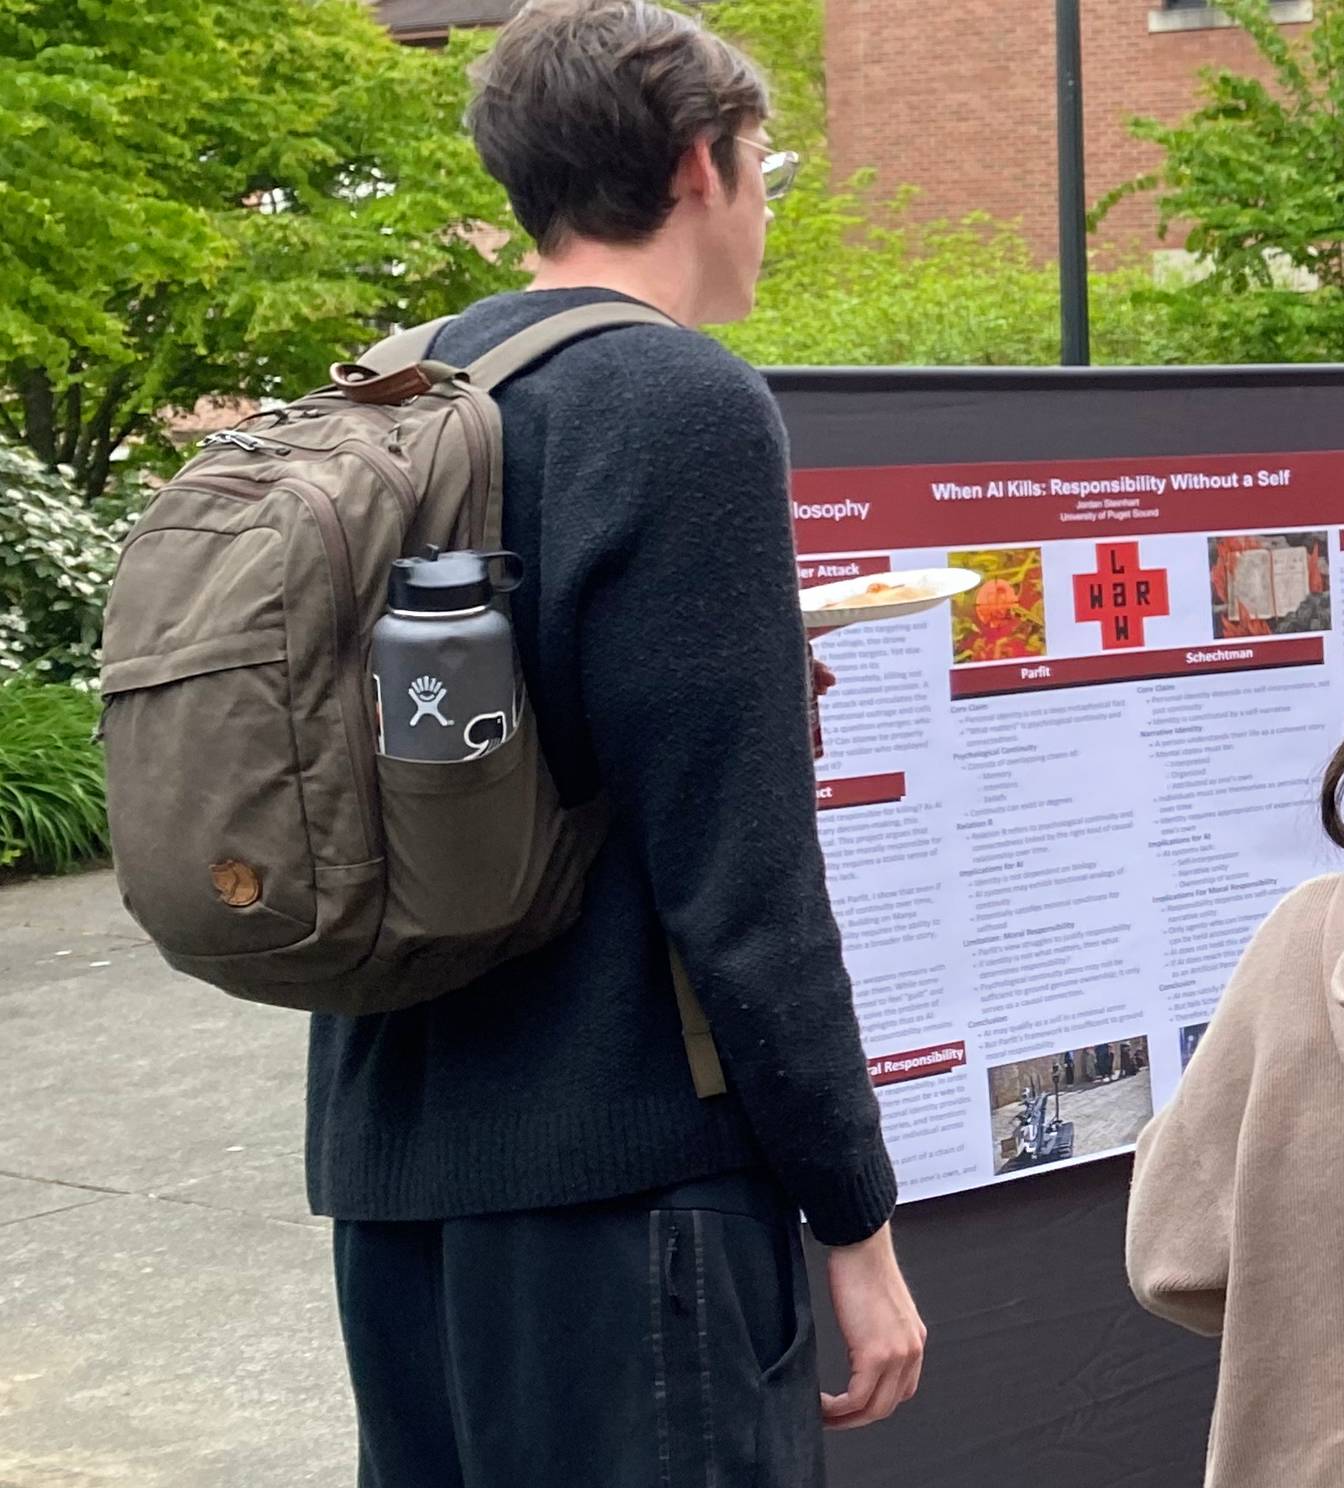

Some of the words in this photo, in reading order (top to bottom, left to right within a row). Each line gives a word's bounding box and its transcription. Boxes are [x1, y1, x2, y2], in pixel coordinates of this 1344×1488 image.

[932, 482, 982, 500] When
[987, 482, 1003, 498] AI
[1008, 480, 1046, 497] Kills:
[1050, 474, 1165, 498] Responsibility
[1171, 472, 1238, 490] Without
[1243, 476, 1253, 486] a
[1258, 470, 1291, 486] Self
[794, 499, 870, 522] losophy
[1060, 512, 1097, 522] University
[1098, 510, 1106, 520] of
[1107, 510, 1131, 520] Puget
[1132, 508, 1159, 518] Sound
[818, 562, 860, 578] Attack
[1186, 648, 1253, 665] Schechtman
[1021, 666, 1051, 679] Parfit
[884, 1048, 964, 1072] Responsibility
